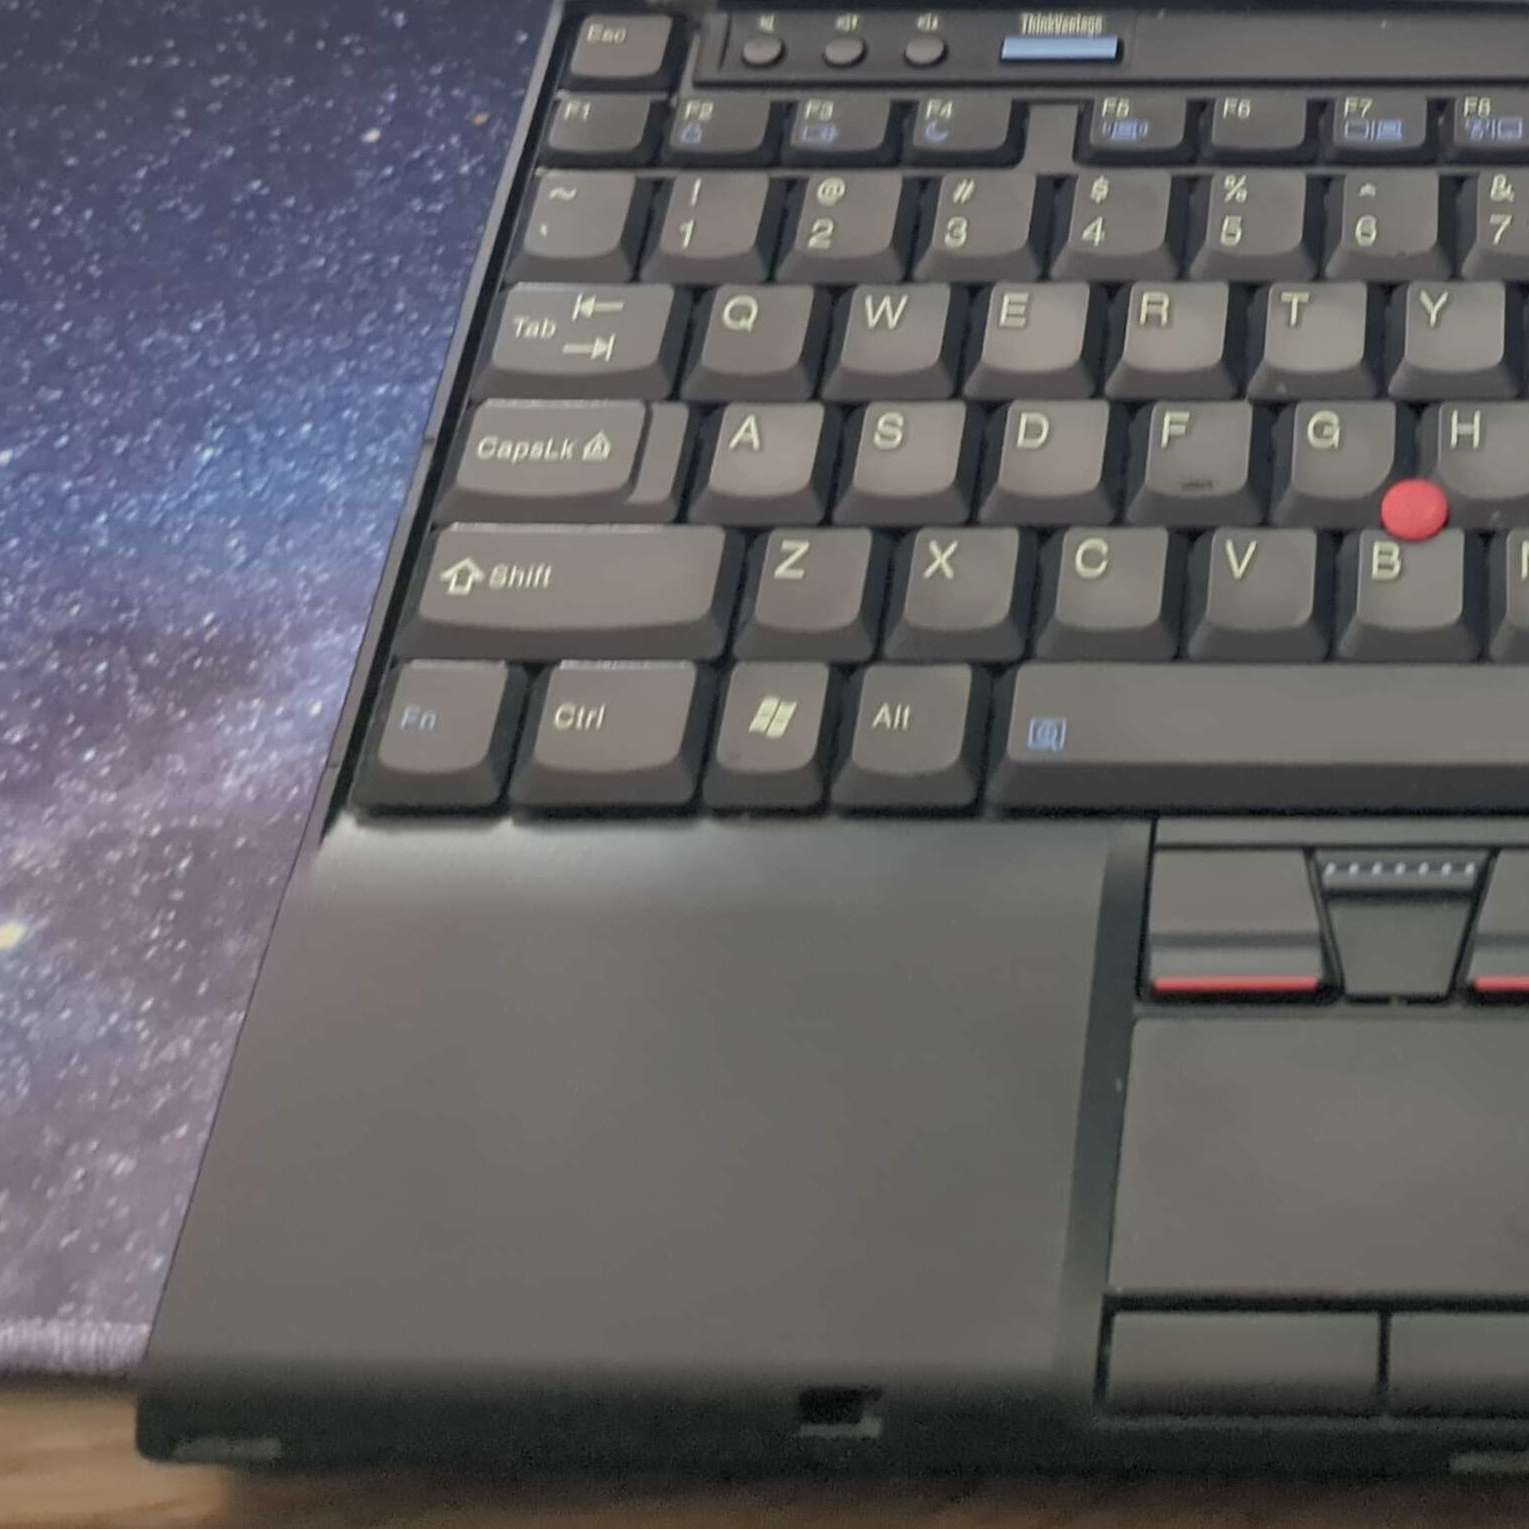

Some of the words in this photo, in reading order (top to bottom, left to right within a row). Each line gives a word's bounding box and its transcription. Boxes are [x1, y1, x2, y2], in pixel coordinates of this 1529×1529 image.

[586, 23, 627, 44] Esc
[1020, 12, 1103, 35] ThinkVantage
[564, 100, 592, 121] F1
[684, 99, 714, 120] F2
[805, 99, 835, 120] F3
[925, 98, 954, 119] F4
[1101, 96, 1131, 119] F5
[1222, 96, 1252, 119] F6
[1344, 96, 1374, 119] F7
[1463, 96, 1491, 118] F8
[815, 176, 846, 207] @
[952, 178, 976, 204] #
[1090, 174, 1110, 204] $
[1223, 174, 1249, 204] %
[1489, 173, 1515, 204] &
[679, 219, 695, 249] 1
[807, 217, 836, 250] 2
[943, 215, 969, 249] 3
[1081, 215, 1106, 247] 4
[1219, 214, 1244, 248] 5
[1354, 214, 1379, 247] 6
[1489, 213, 1513, 246] 7
[722, 293, 759, 333] Q
[864, 293, 909, 331] W
[999, 291, 1030, 328] E
[1138, 290, 1171, 327] R
[1281, 290, 1311, 327] T
[1419, 289, 1449, 327] Y
[512, 315, 557, 340] Tab
[728, 413, 762, 452] A
[872, 410, 905, 451] S
[1015, 410, 1051, 450] D
[1160, 410, 1191, 450] F
[1306, 409, 1342, 451] G
[1450, 408, 1482, 451] H
[476, 434, 575, 466] CapsLk
[772, 539, 811, 581] Z
[922, 539, 959, 581] X
[1074, 536, 1110, 580] C
[1224, 537, 1258, 581] V
[1370, 539, 1402, 582] B
[487, 563, 553, 591] Shift
[400, 704, 438, 732] Fn
[553, 701, 608, 731] Ctrl
[870, 701, 912, 732] Alt
